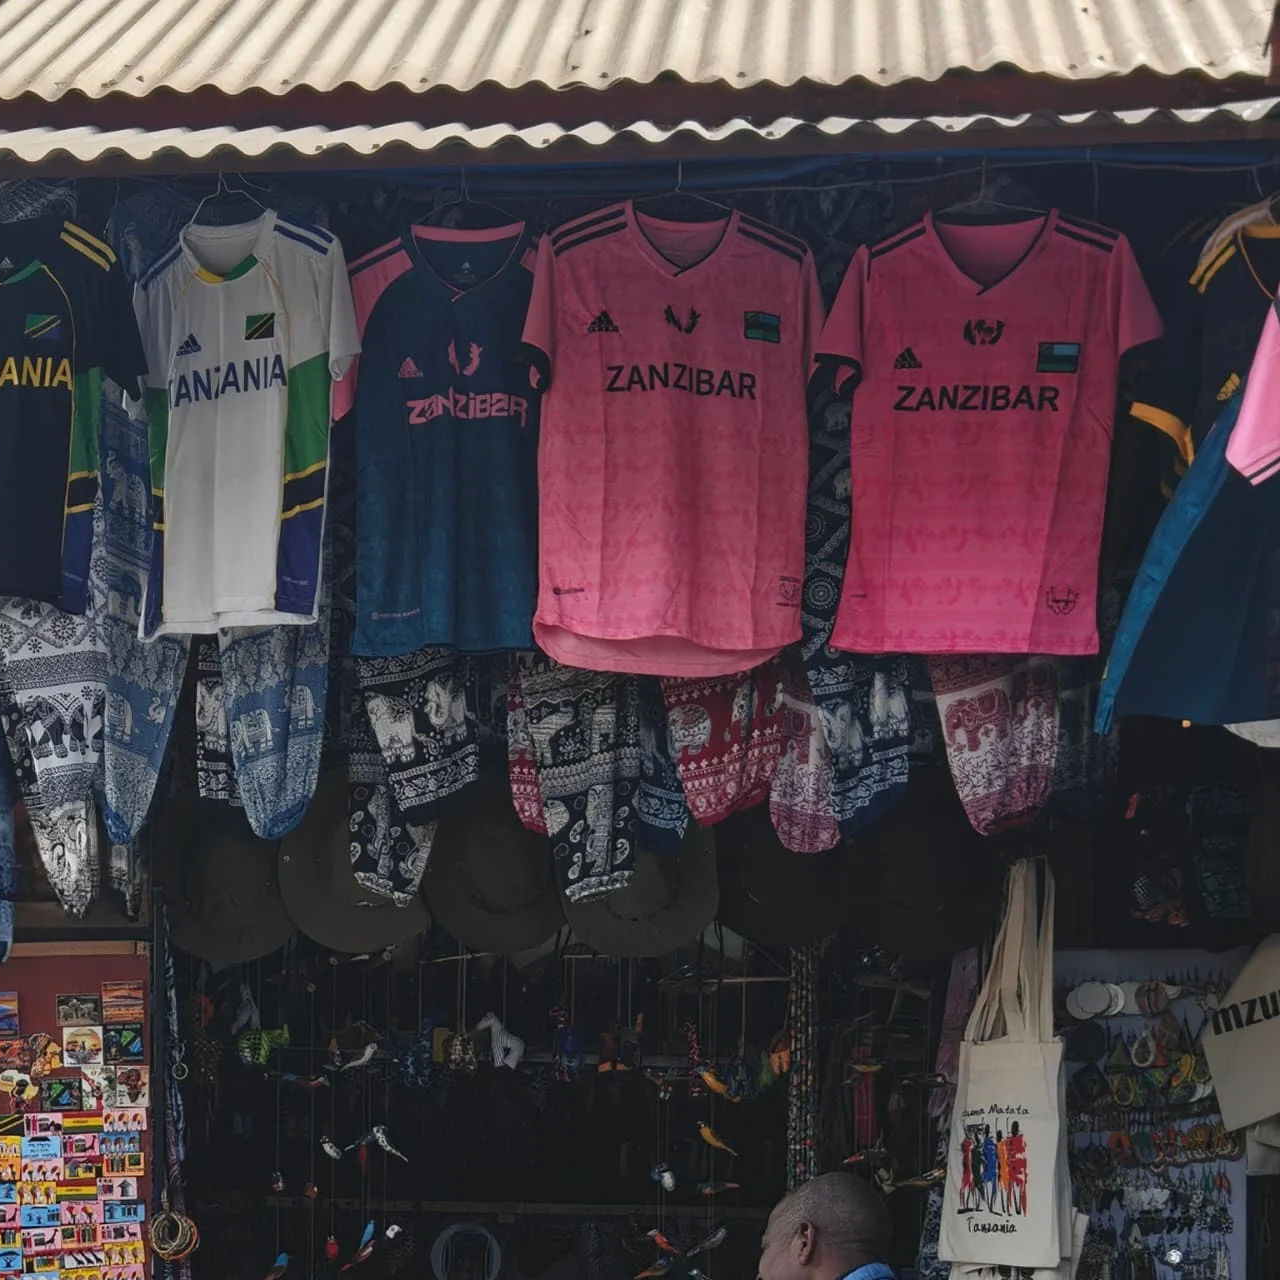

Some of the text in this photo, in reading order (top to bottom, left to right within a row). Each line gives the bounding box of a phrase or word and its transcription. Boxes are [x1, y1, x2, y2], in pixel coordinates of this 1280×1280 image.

[606, 361, 757, 401] ZANZIBAR
[893, 383, 1061, 413] ZANZIBAR
[1211, 989, 1280, 1036] mzu
[966, 1216, 1018, 1234] Tanzania
